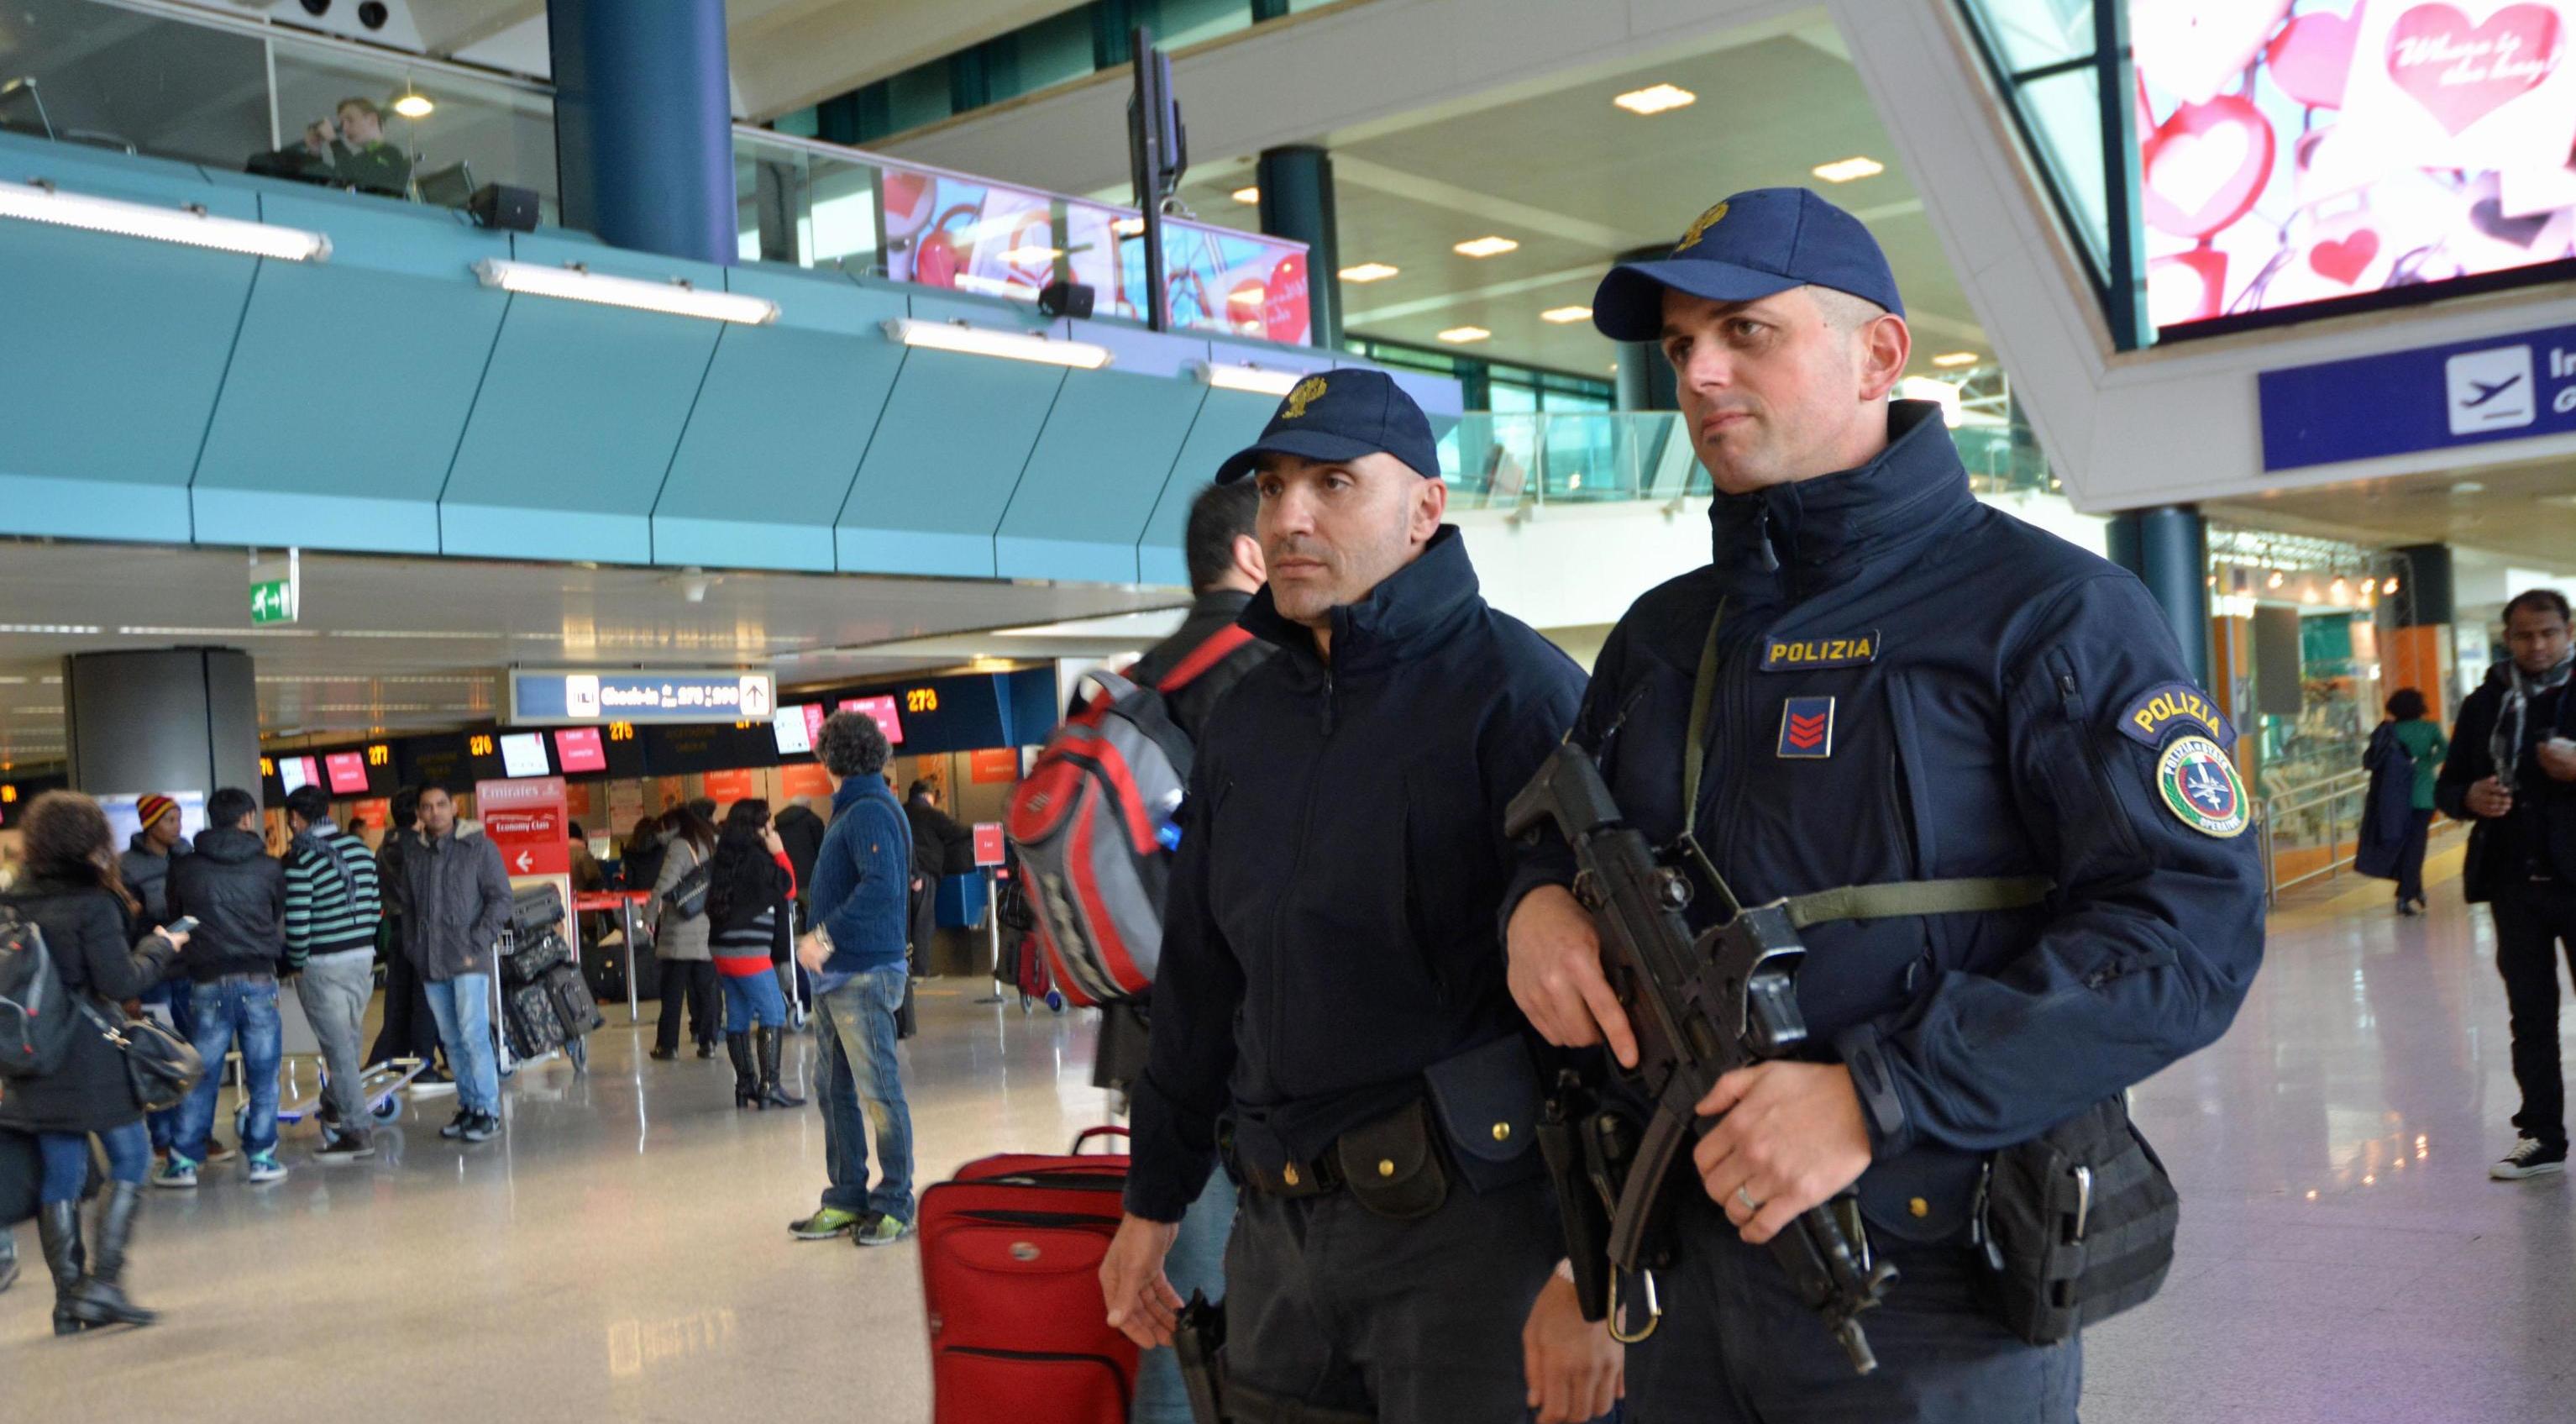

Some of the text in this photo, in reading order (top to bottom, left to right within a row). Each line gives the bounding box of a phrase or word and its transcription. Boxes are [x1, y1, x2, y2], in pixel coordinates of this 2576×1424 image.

[1770, 638, 1871, 663] POLIZIA
[907, 688, 937, 712] 273
[2133, 691, 2220, 738] POLIZIA
[610, 721, 633, 741] 275
[368, 744, 388, 765] 277
[470, 734, 492, 755] 276
[2164, 742, 2195, 775] POLIZIA
[481, 785, 540, 800] Emirates
[496, 821, 531, 833] Economy
